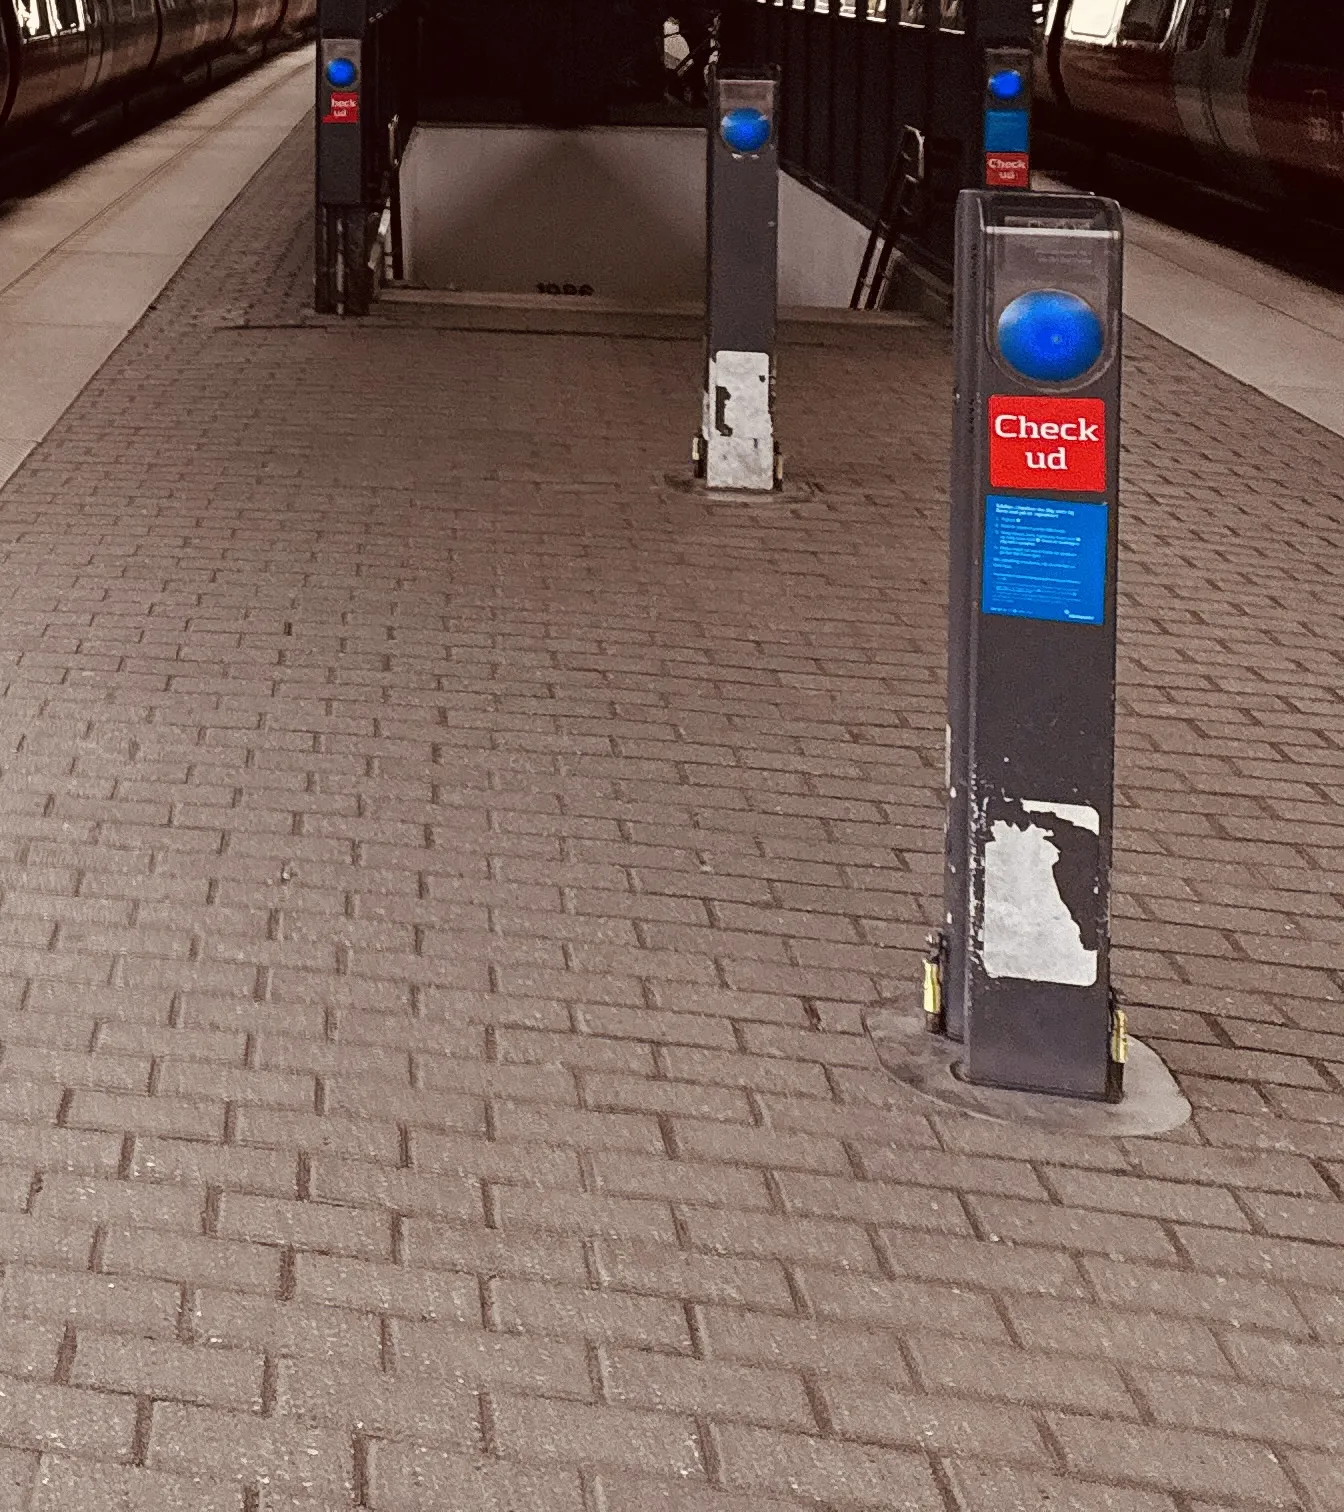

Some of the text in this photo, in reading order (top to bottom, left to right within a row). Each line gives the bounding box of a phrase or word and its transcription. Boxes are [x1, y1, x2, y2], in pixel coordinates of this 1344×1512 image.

[331, 98, 357, 108] heck
[988, 158, 1026, 169] Check
[998, 171, 1016, 180] ud
[994, 414, 1100, 442] Check
[1024, 446, 1069, 470] ud
